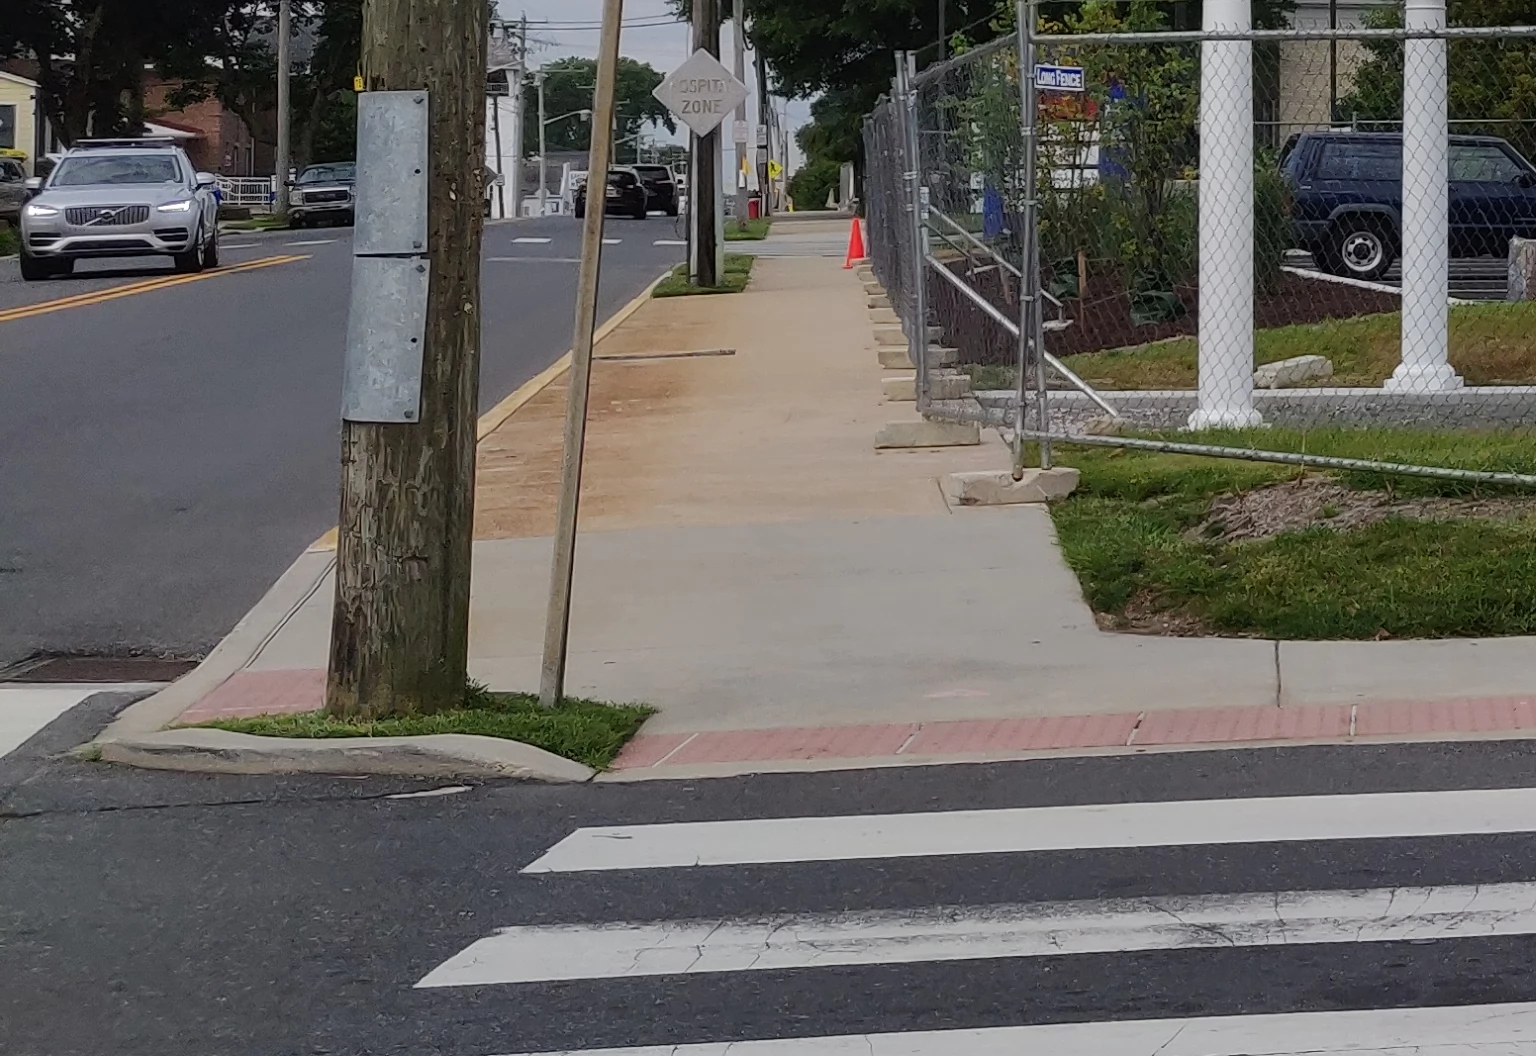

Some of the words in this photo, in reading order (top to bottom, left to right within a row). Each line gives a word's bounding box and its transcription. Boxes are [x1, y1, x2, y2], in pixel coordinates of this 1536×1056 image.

[1037, 68, 1056, 85] LONG
[1056, 70, 1081, 86] FENCE
[681, 100, 722, 114] ZONE
